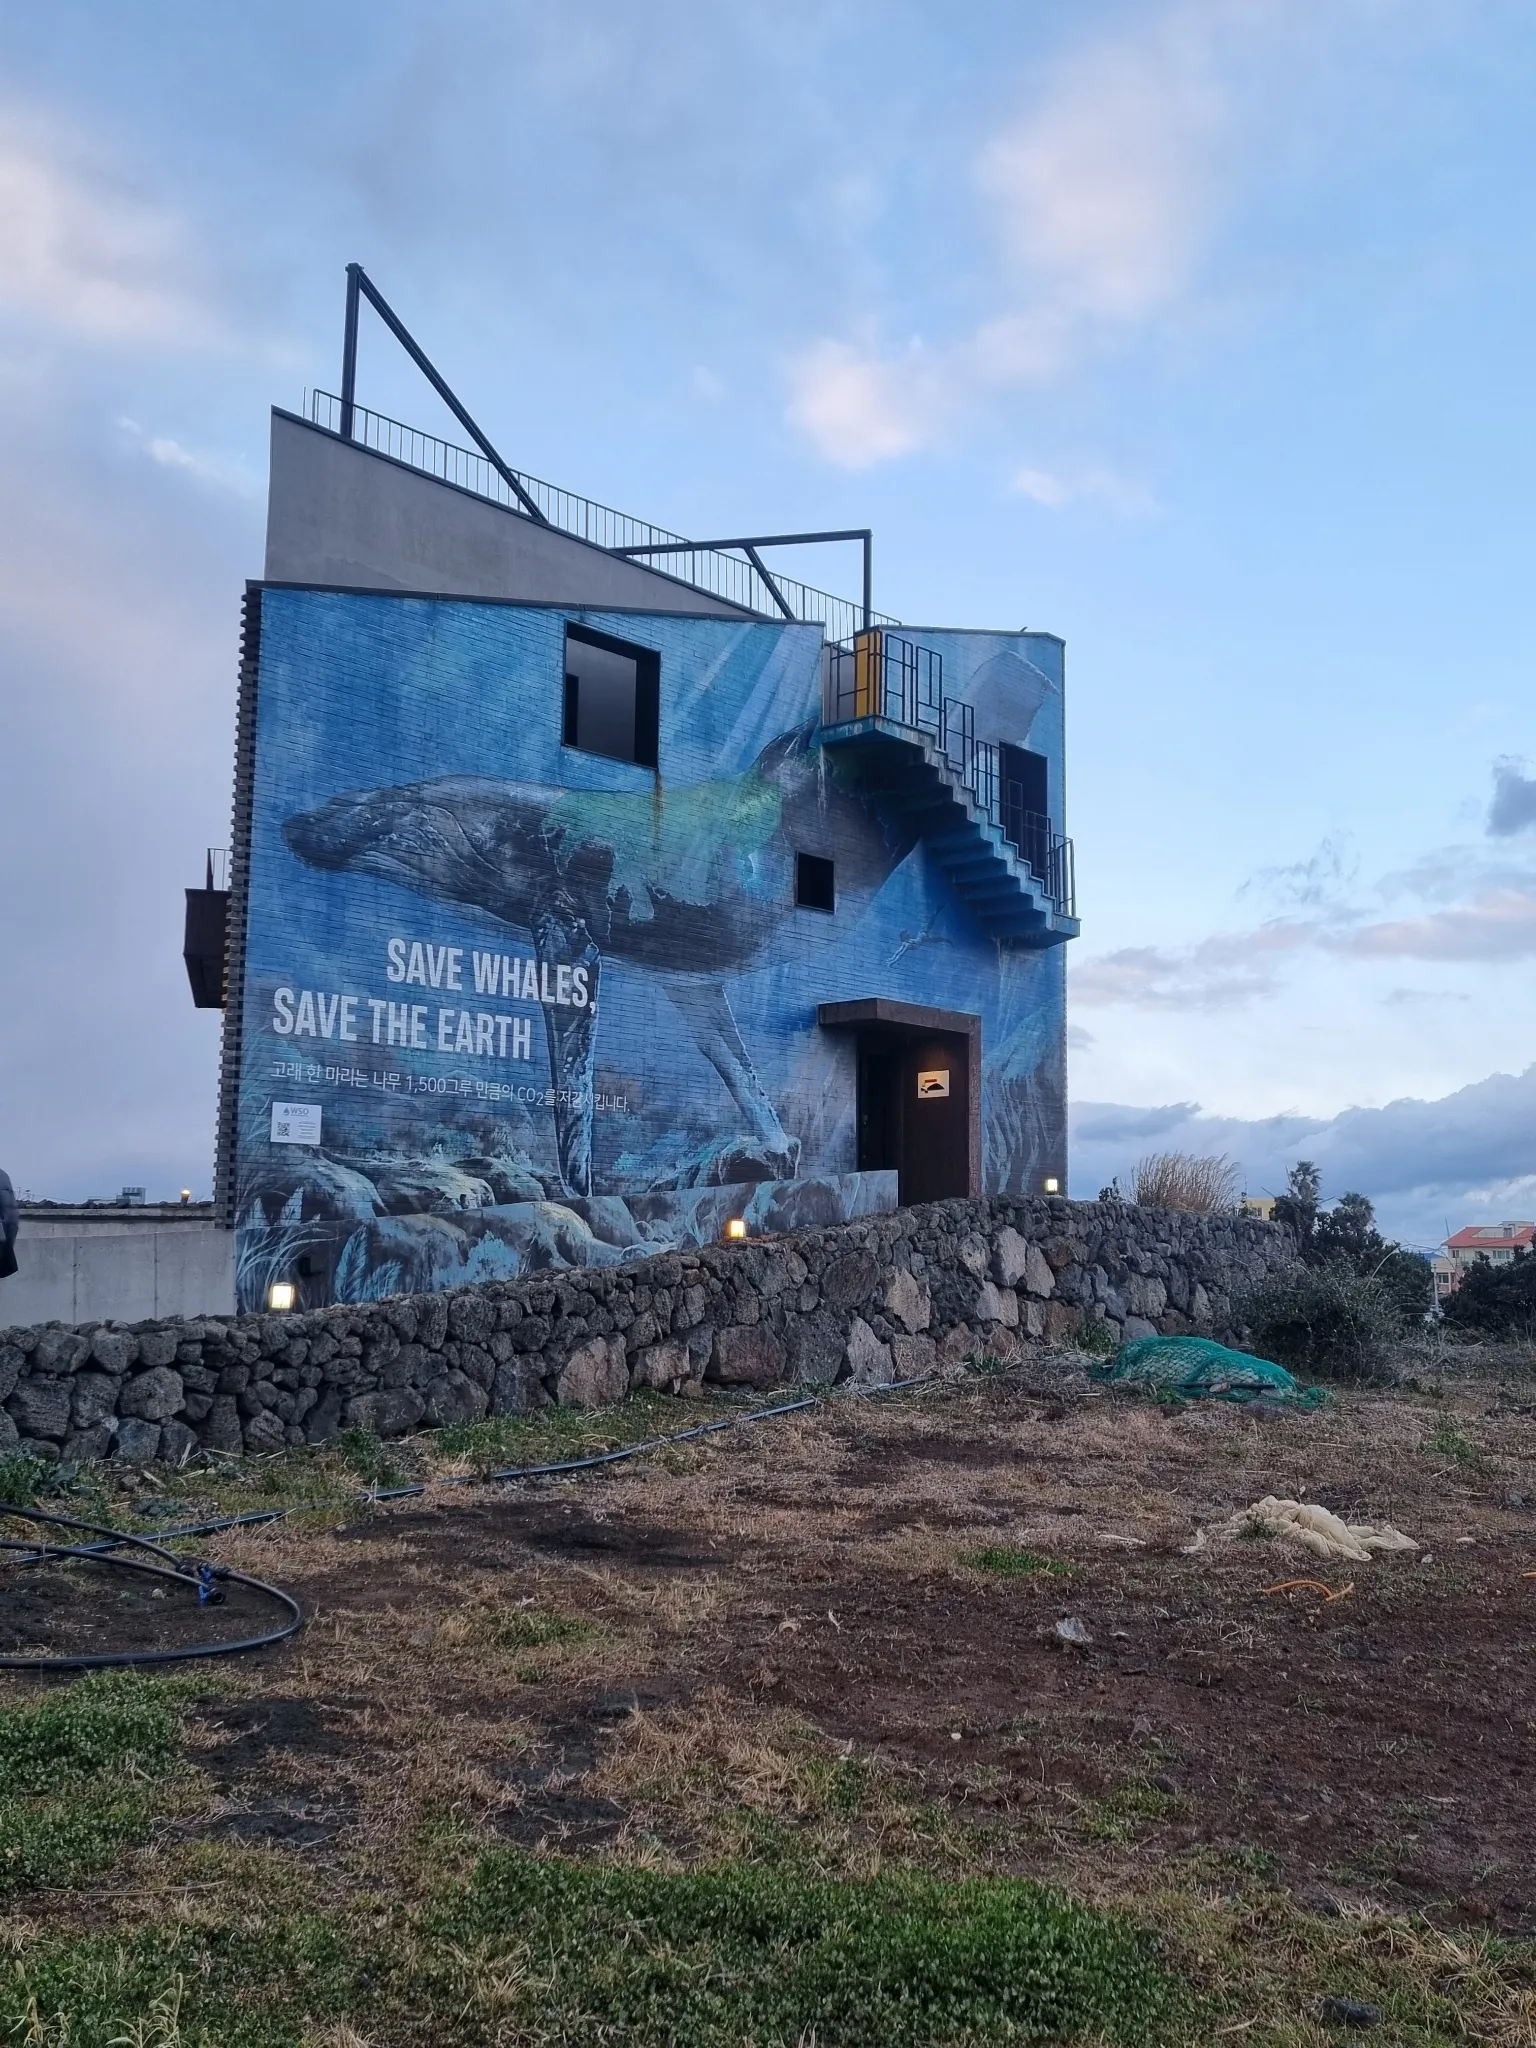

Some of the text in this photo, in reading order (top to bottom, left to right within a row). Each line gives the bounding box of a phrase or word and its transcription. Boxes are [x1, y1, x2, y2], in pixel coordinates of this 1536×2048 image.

[387, 938, 596, 1014] SAVE WHALES,
[272, 987, 531, 1060] SAVE THE EARTH
[270, 1061, 302, 1082] 고래
[306, 1064, 323, 1083] 한
[325, 1066, 369, 1088] 마리는
[373, 1071, 402, 1091] 나무
[406, 1075, 472, 1098] 1,500그루
[475, 1081, 514, 1102] 만큼의
[290, 1107, 309, 1115] WSO
